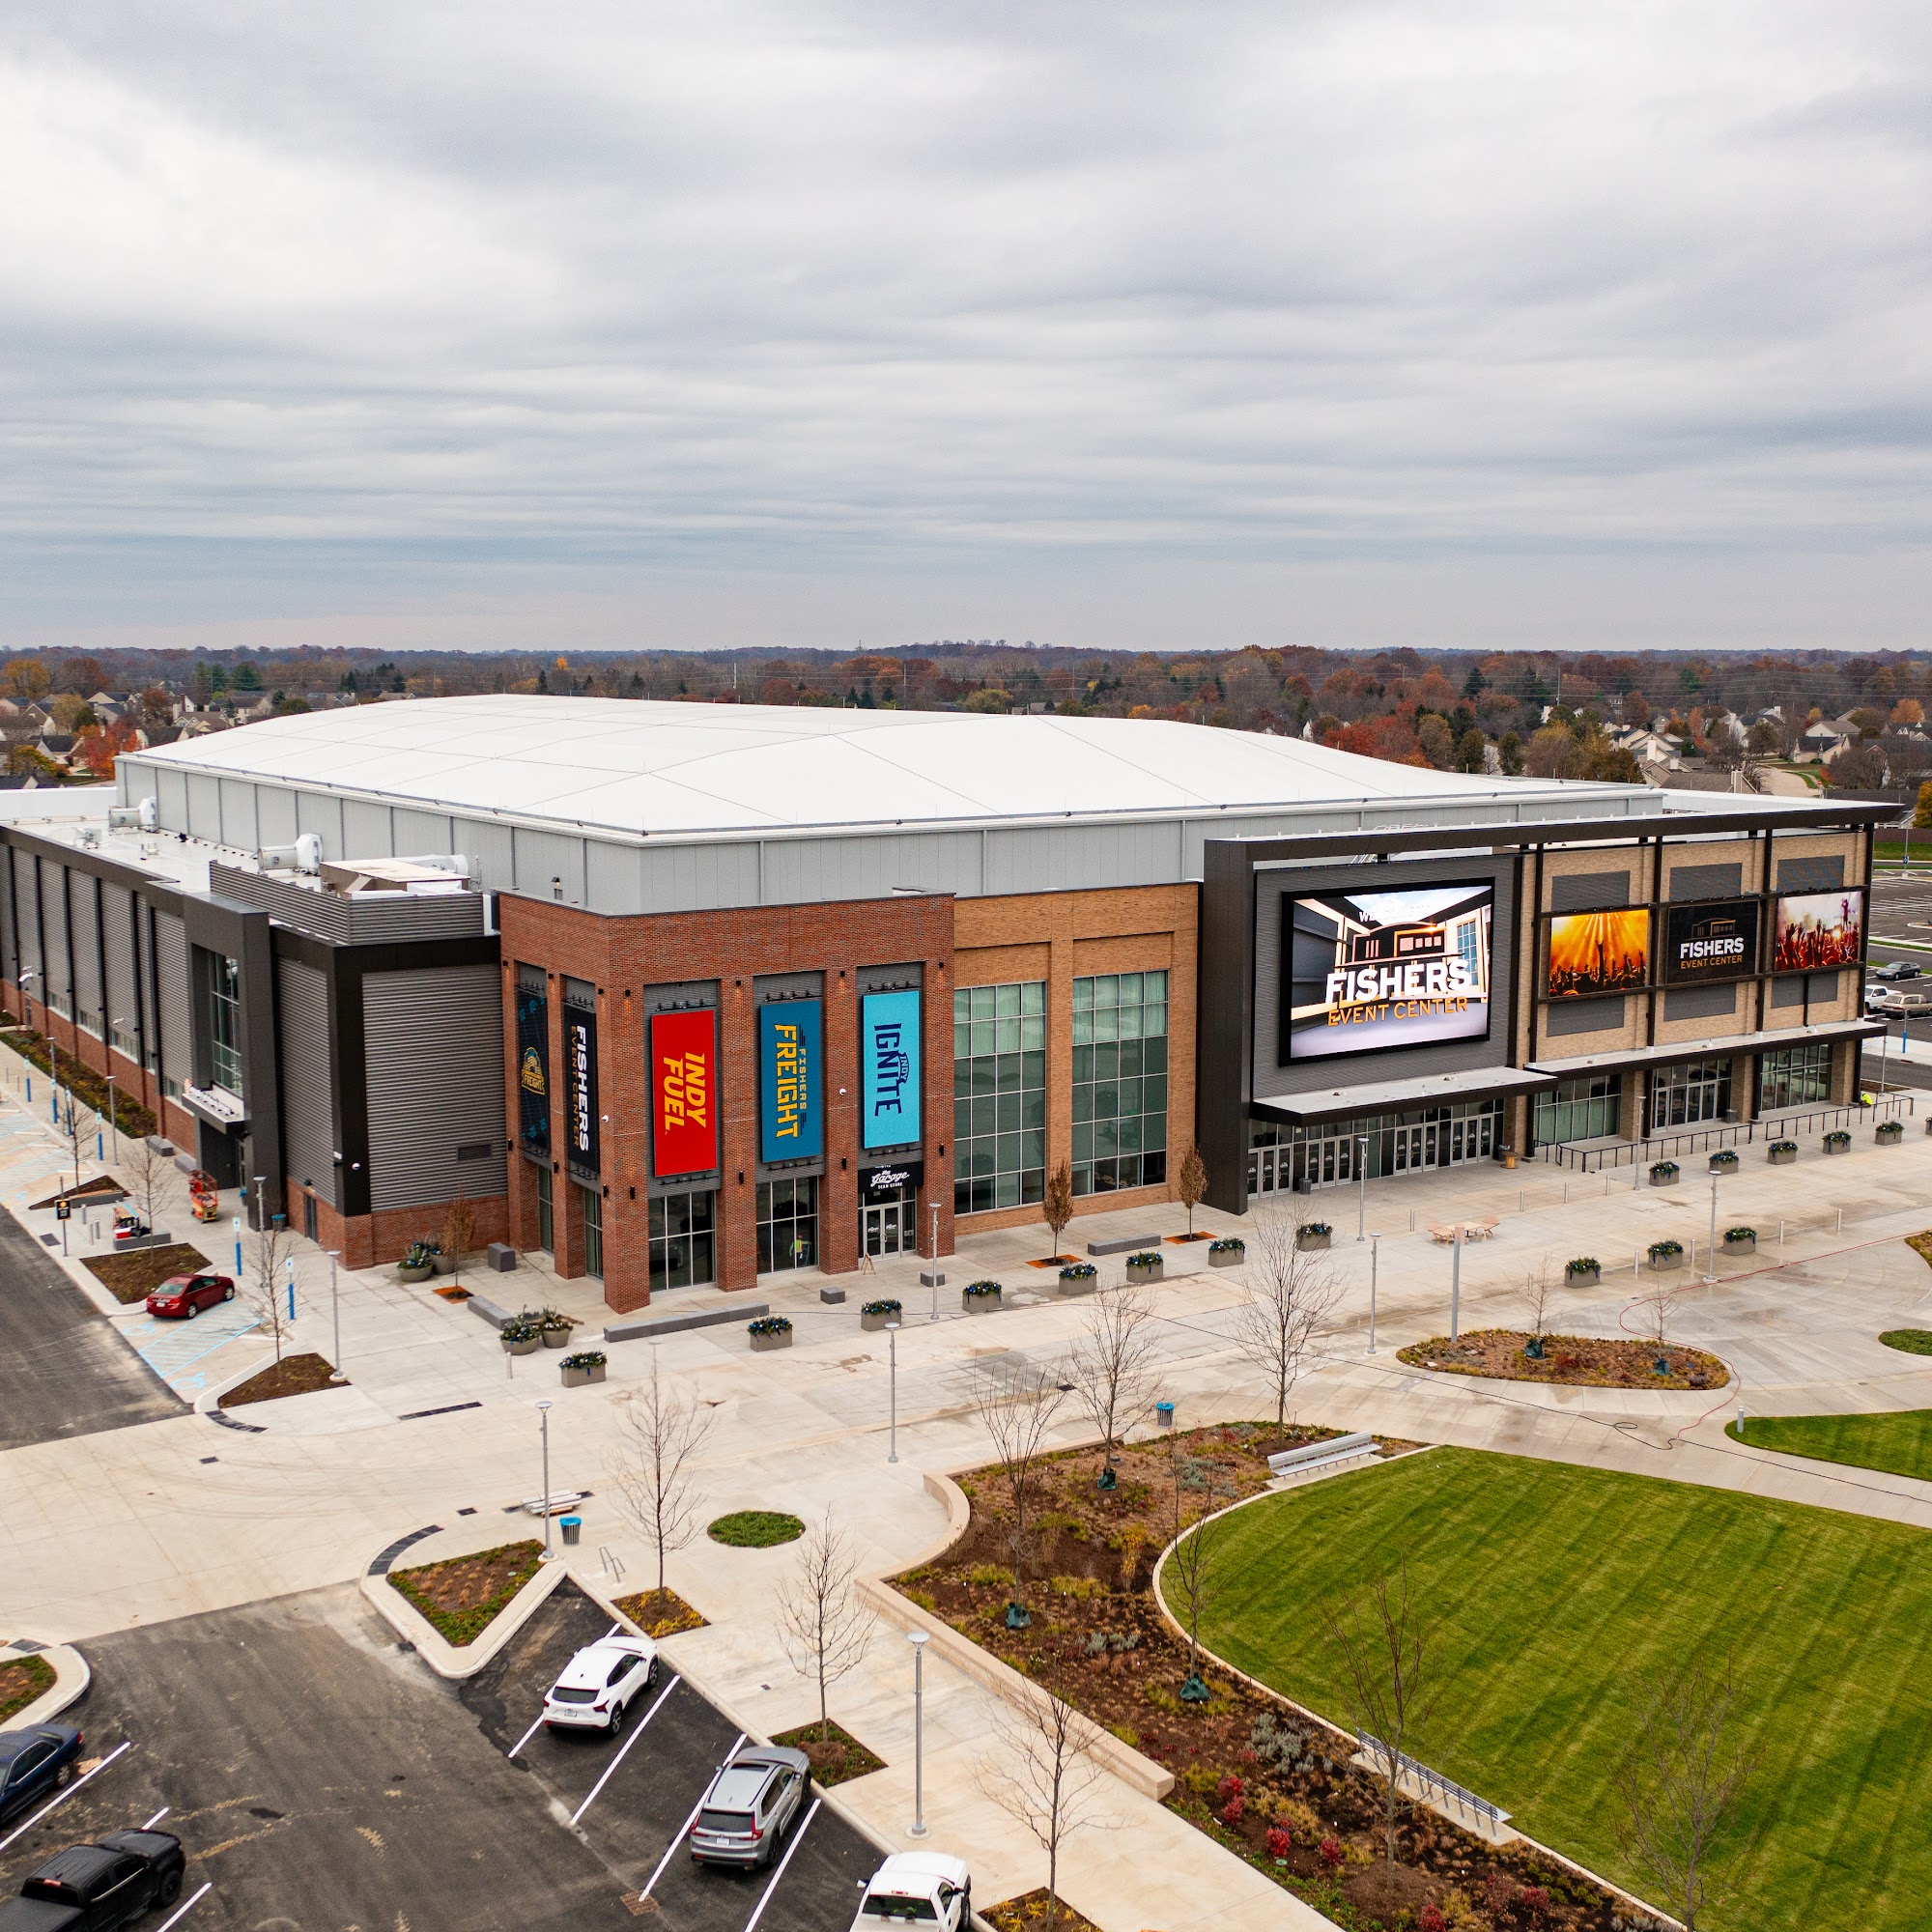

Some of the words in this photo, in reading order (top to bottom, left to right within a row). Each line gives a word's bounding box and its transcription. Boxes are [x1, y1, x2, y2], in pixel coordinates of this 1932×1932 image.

[1680, 937, 1744, 959] FISHERS
[1681, 958, 1709, 969] EVENT
[1710, 954, 1743, 966] CENTER
[1324, 958, 1472, 1006] FISHERS
[1328, 1003, 1389, 1027] EVENT
[1393, 996, 1468, 1019] CENTER
[577, 1025, 589, 1151] FISHERS
[664, 1057, 685, 1131] FUEL
[685, 1052, 706, 1128] INDY
[774, 1024, 798, 1138] FREIGHT
[799, 1048, 808, 1110] FISHERS
[873, 1023, 902, 1117] IGNITE
[899, 1055, 908, 1081] INDY
[870, 1172, 910, 1187] Garage
